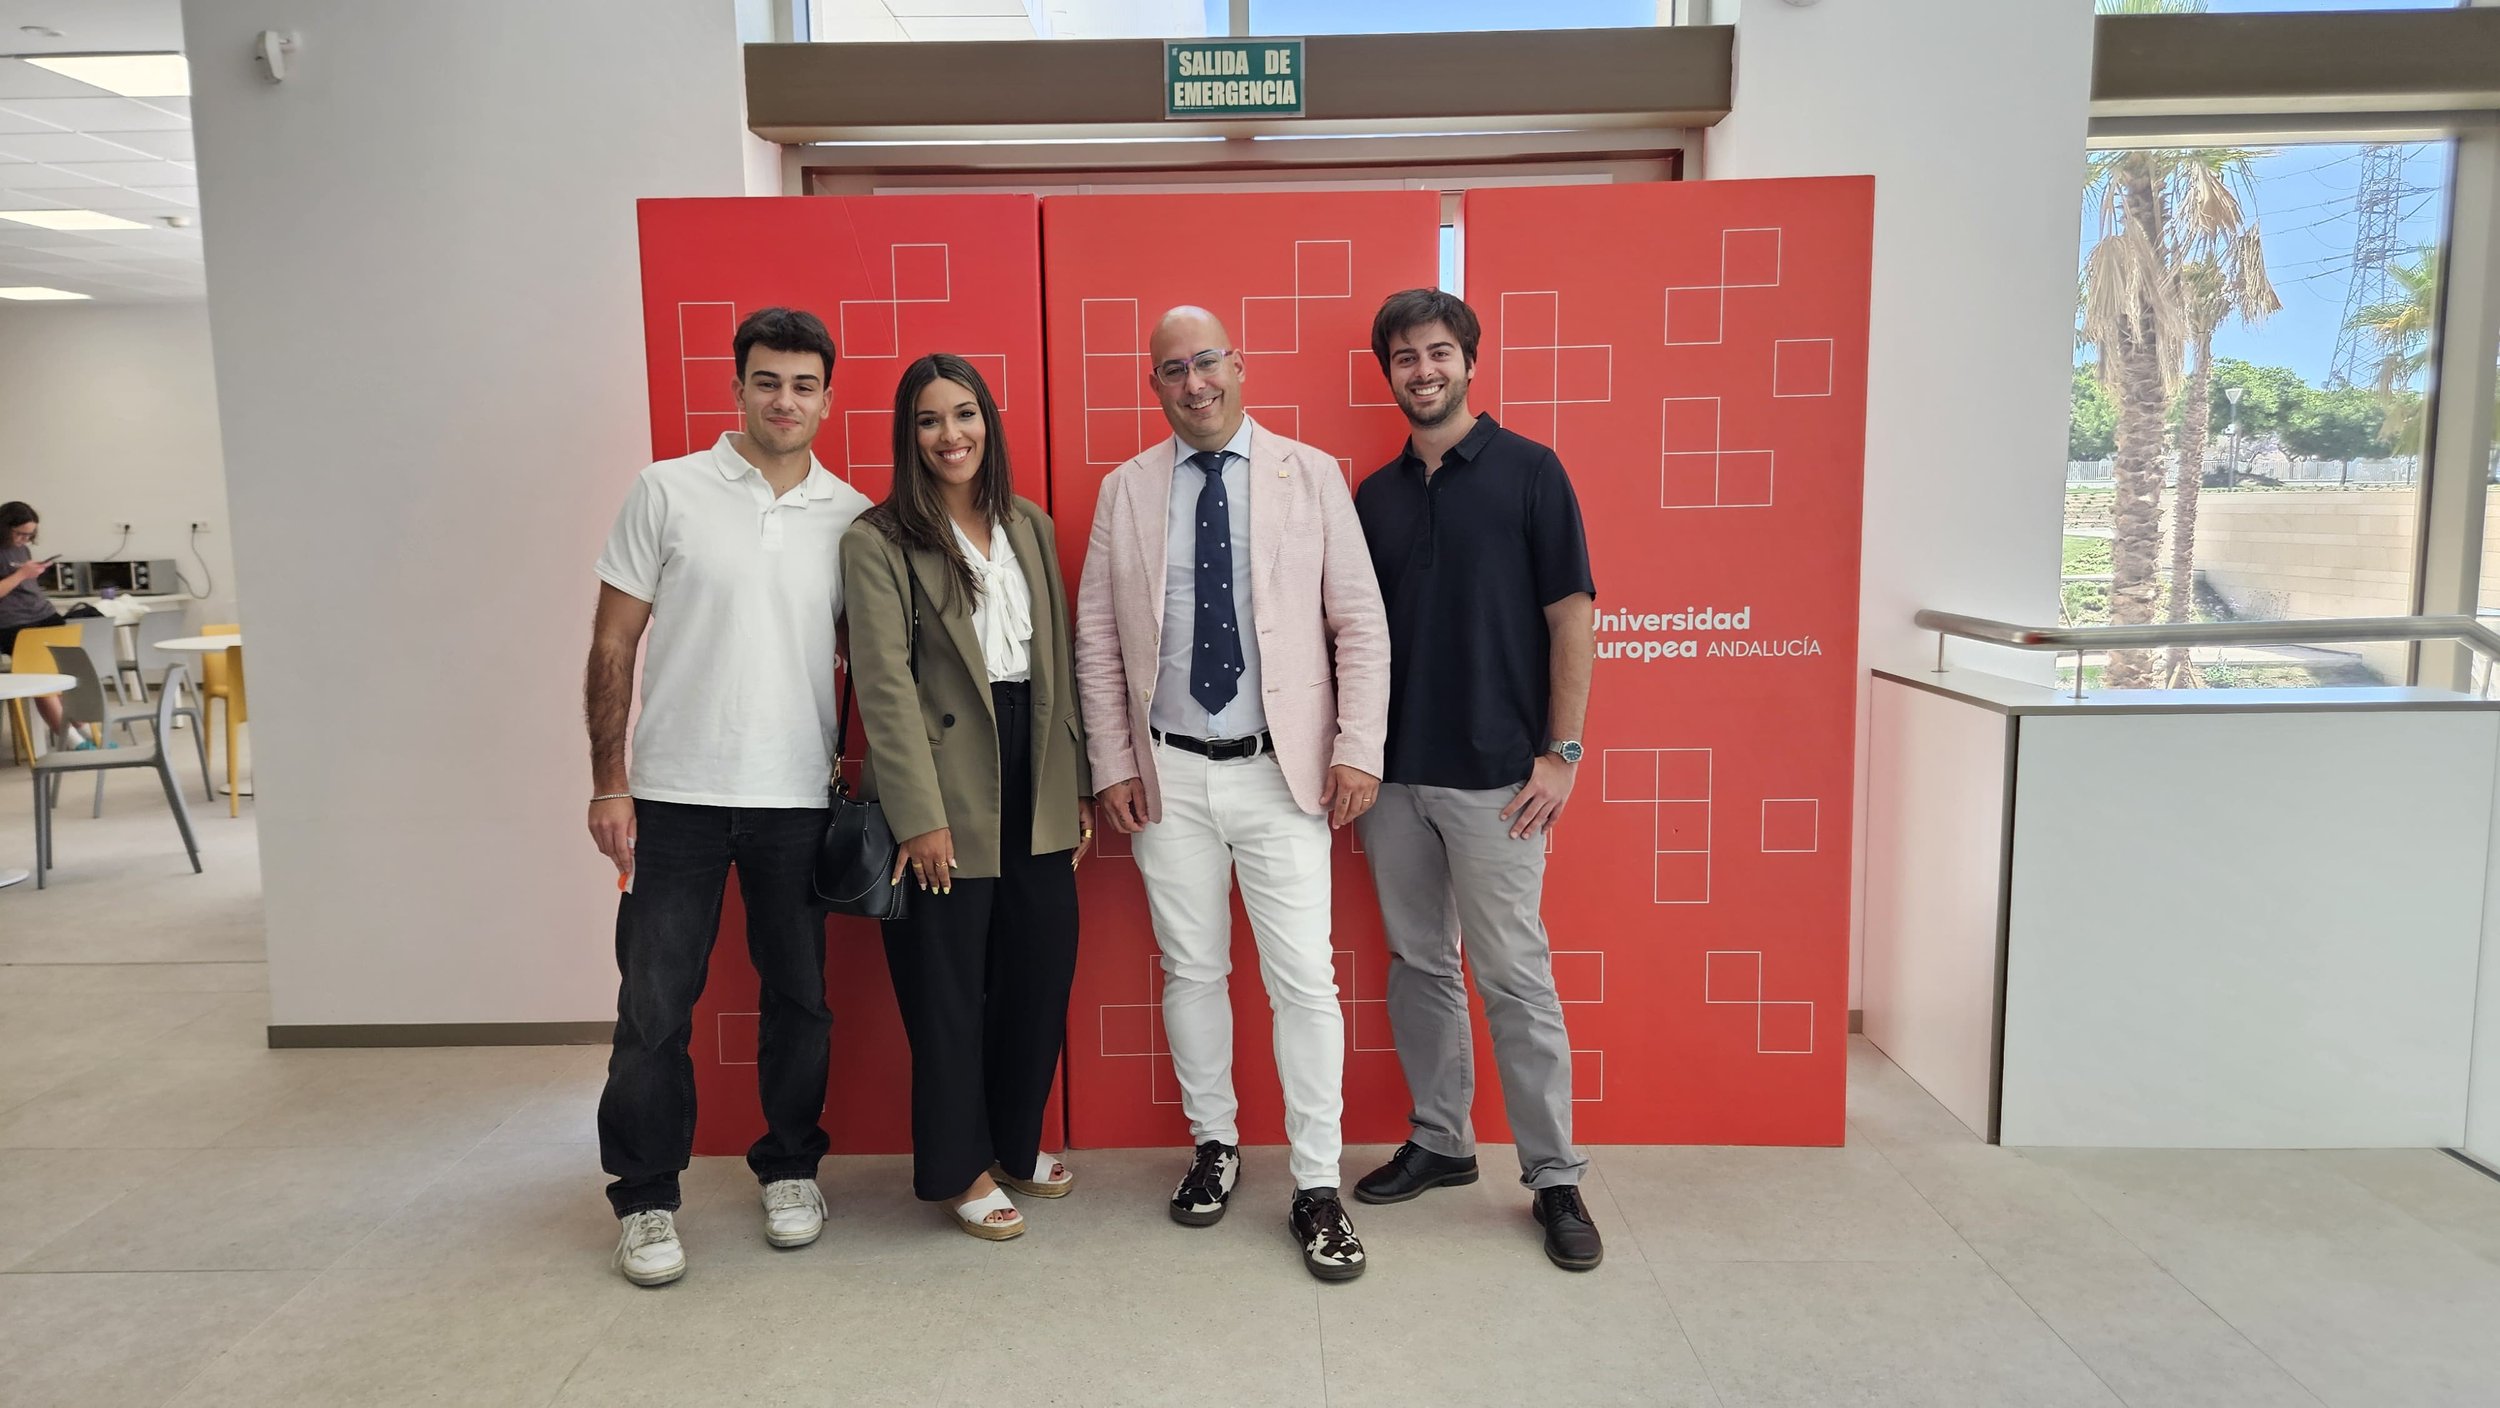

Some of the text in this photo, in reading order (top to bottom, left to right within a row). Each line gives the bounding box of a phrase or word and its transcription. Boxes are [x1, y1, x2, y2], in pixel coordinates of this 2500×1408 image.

[1178, 49, 1291, 76] SALIDA DE
[1173, 80, 1297, 107] EMERGENCIA
[1594, 636, 1823, 663] uropea ANDALUCÍA
